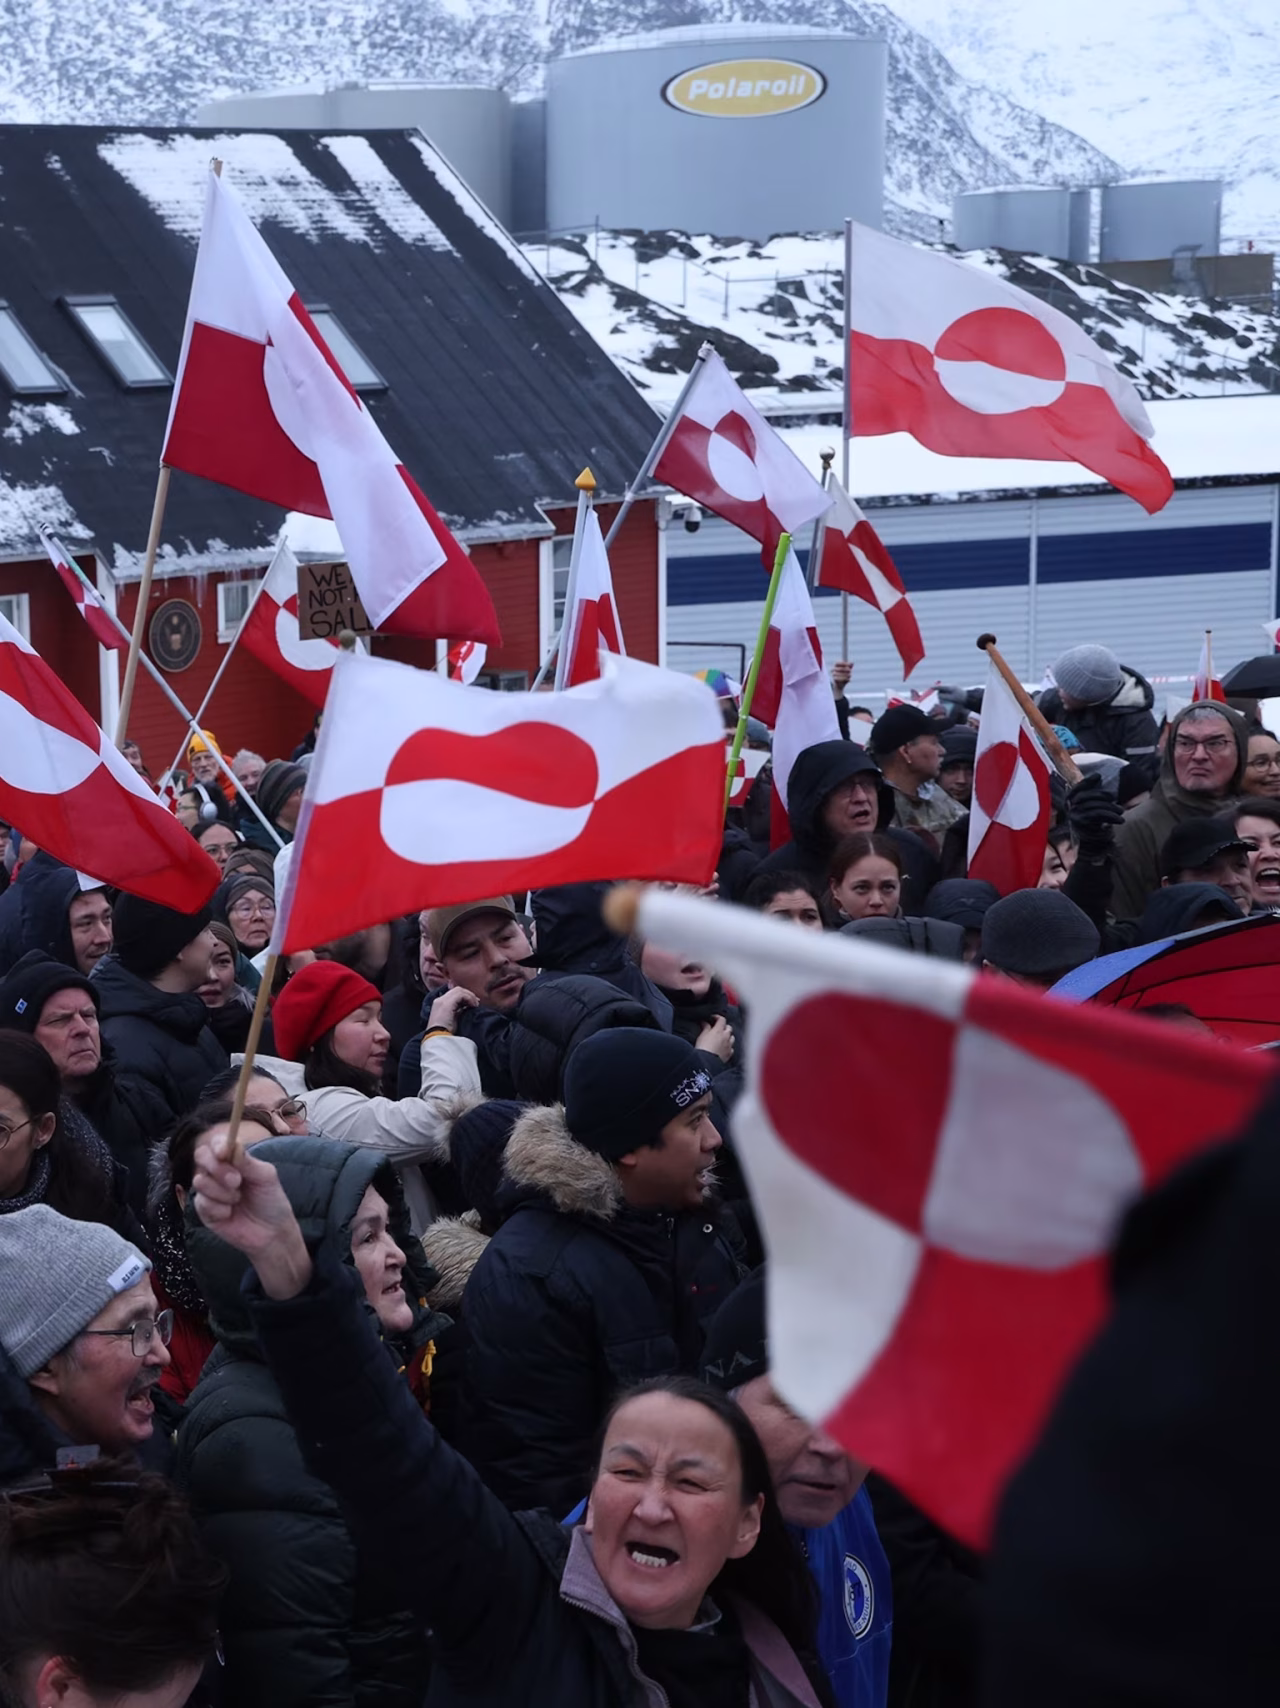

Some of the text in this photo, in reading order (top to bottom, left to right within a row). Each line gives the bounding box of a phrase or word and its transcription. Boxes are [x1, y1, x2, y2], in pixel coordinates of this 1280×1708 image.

[688, 74, 807, 101] Polaroil
[308, 564, 346, 588] WE
[308, 585, 348, 609] NOT
